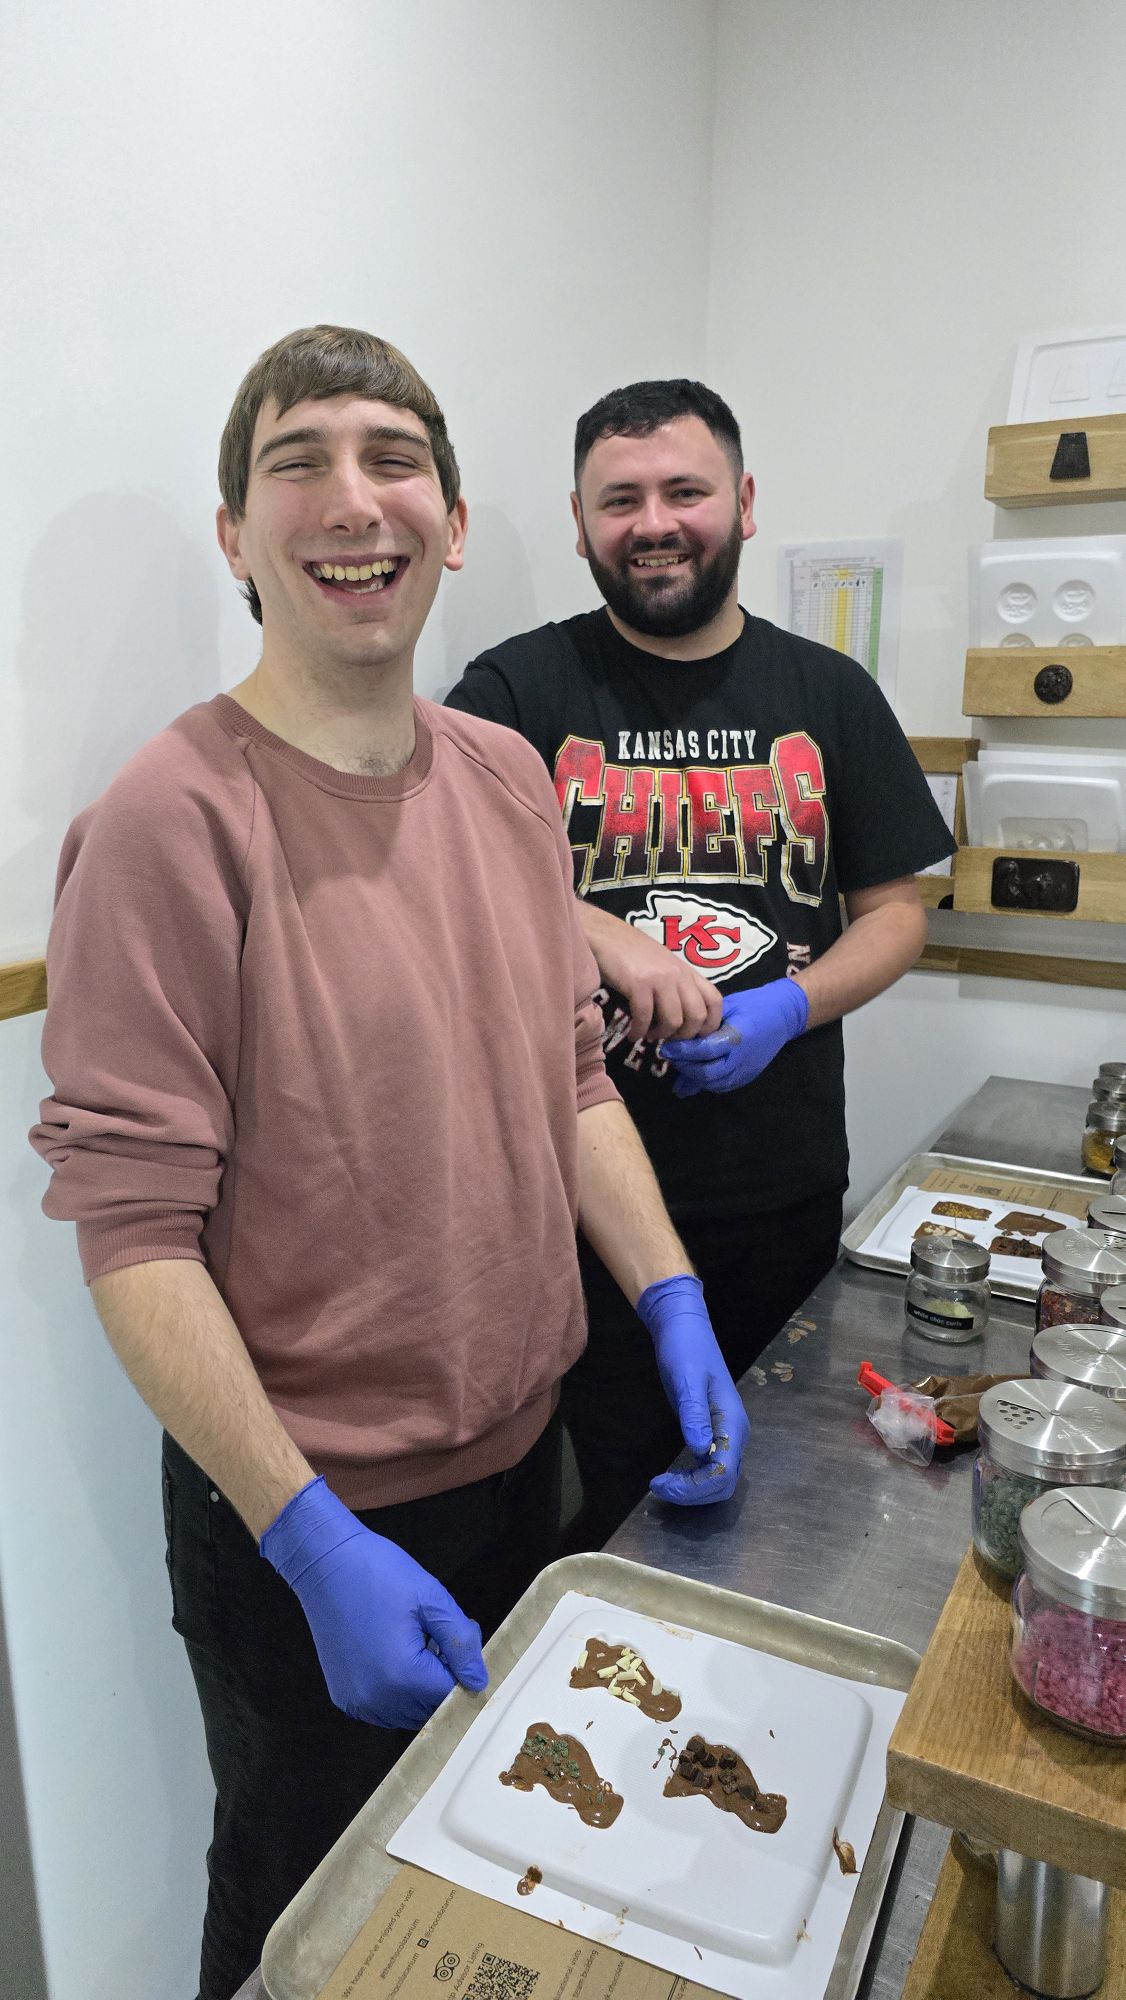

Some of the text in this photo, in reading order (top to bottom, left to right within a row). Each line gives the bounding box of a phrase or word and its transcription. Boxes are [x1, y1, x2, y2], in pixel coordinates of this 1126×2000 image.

[617, 730, 757, 761] KANSAS CITY
[554, 731, 828, 908] CHIEFS
[660, 915, 741, 968] KC
[913, 1309, 963, 1328] white choc curls
[350, 1965, 367, 1985] hope
[377, 1917, 397, 1945] enjoyed
[394, 1902, 407, 1919] your
[453, 1965, 471, 1992] Advisor
[466, 1942, 485, 1964] Listing
[580, 1949, 599, 1978] building
